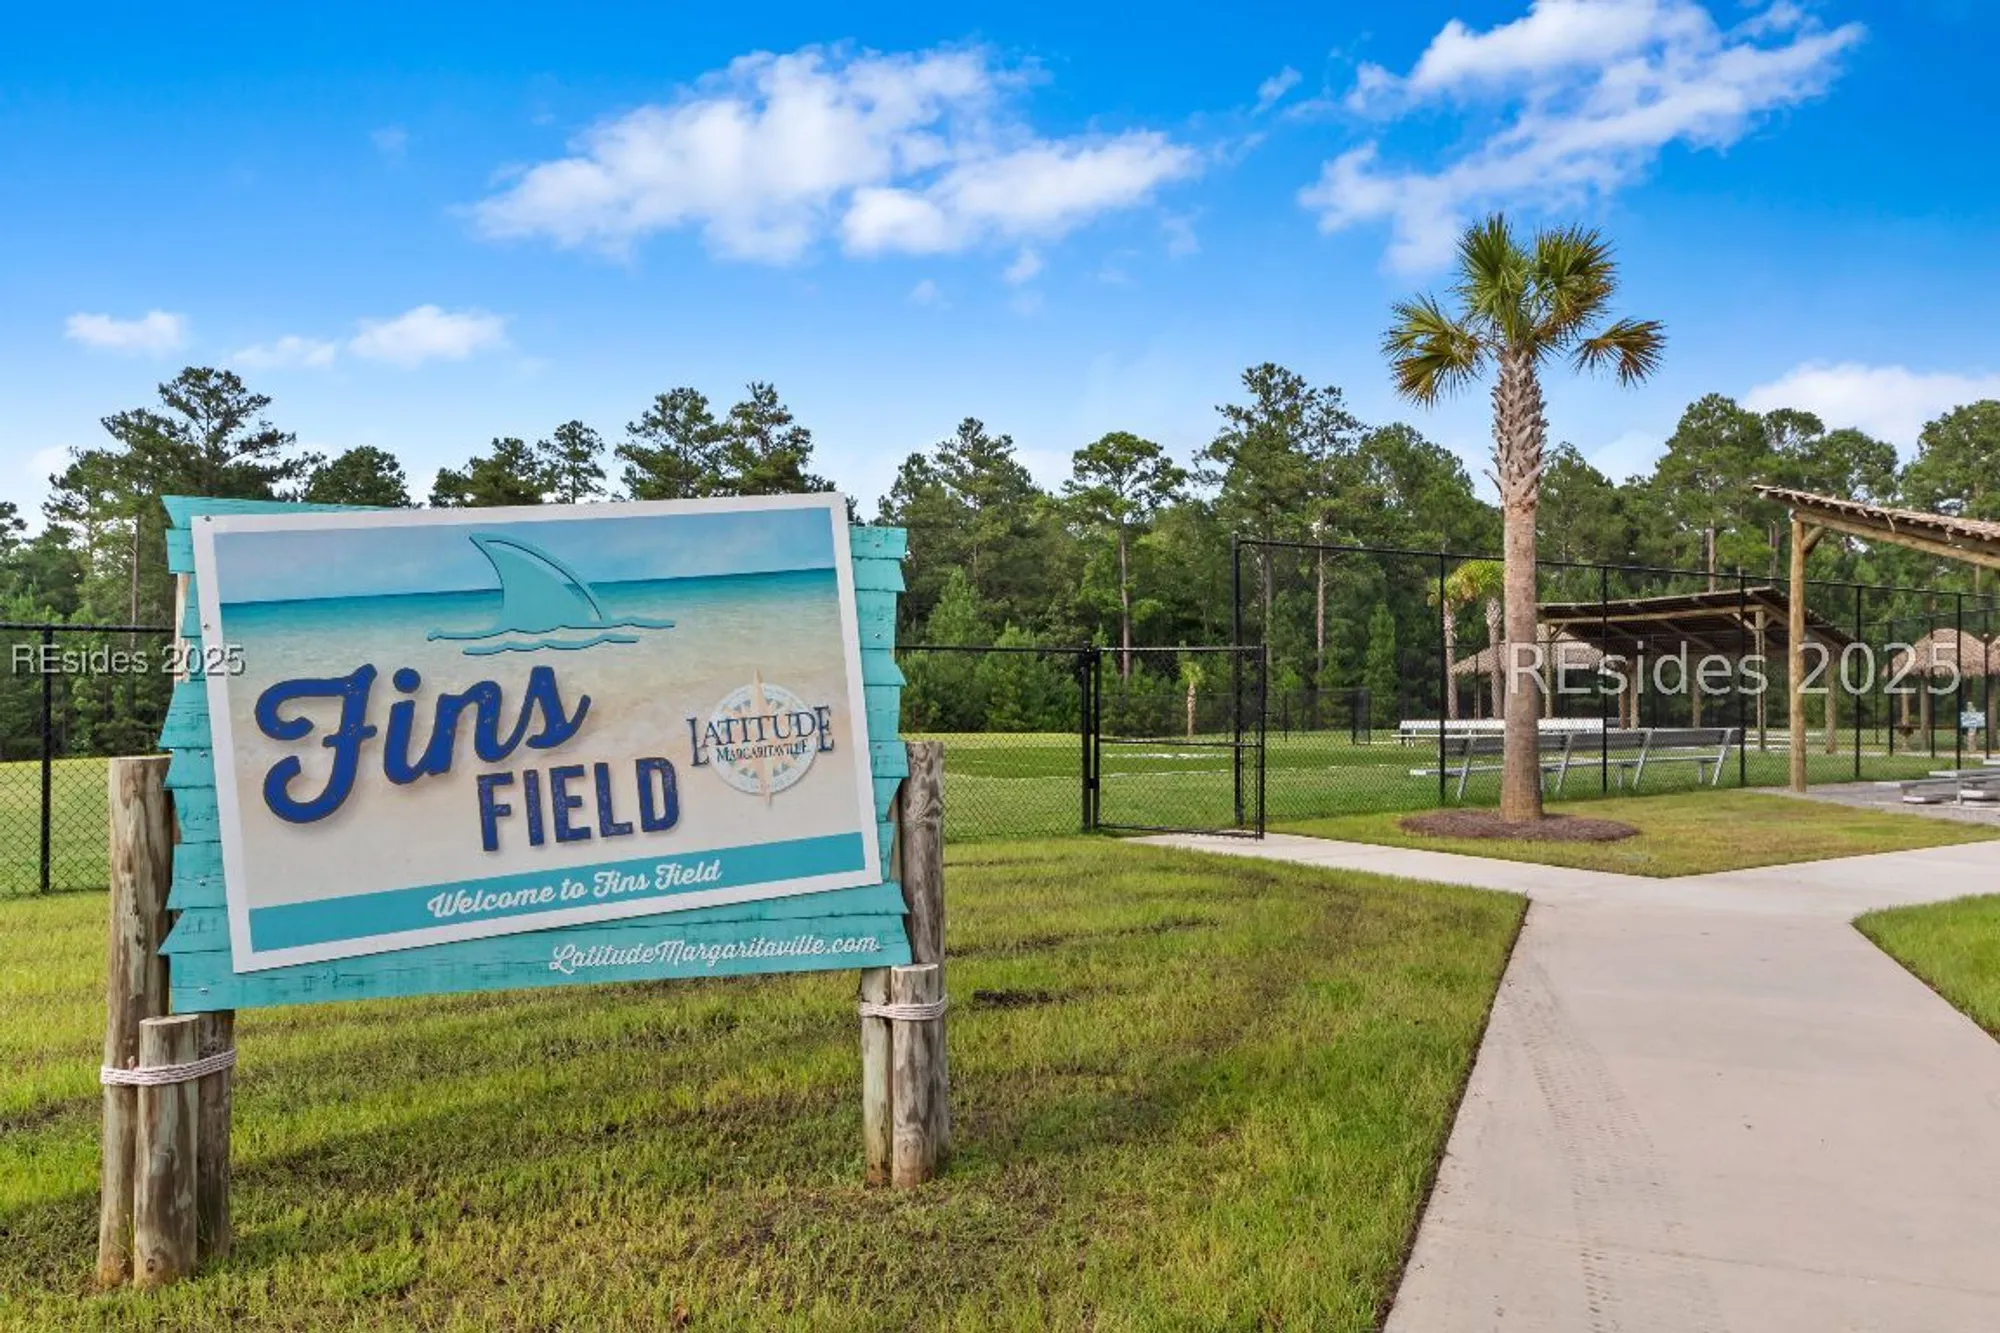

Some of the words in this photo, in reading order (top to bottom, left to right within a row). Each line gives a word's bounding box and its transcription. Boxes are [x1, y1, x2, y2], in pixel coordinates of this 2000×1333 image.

[254, 663, 591, 824] Fins
[686, 704, 835, 767] LATITUDE
[476, 756, 680, 852] FIELD
[427, 885, 555, 918] Welcome
[560, 878, 588, 900] to
[594, 869, 651, 898] Fins
[655, 859, 723, 890] Field
[549, 935, 881, 975] LatitudeMargaritaville.com
